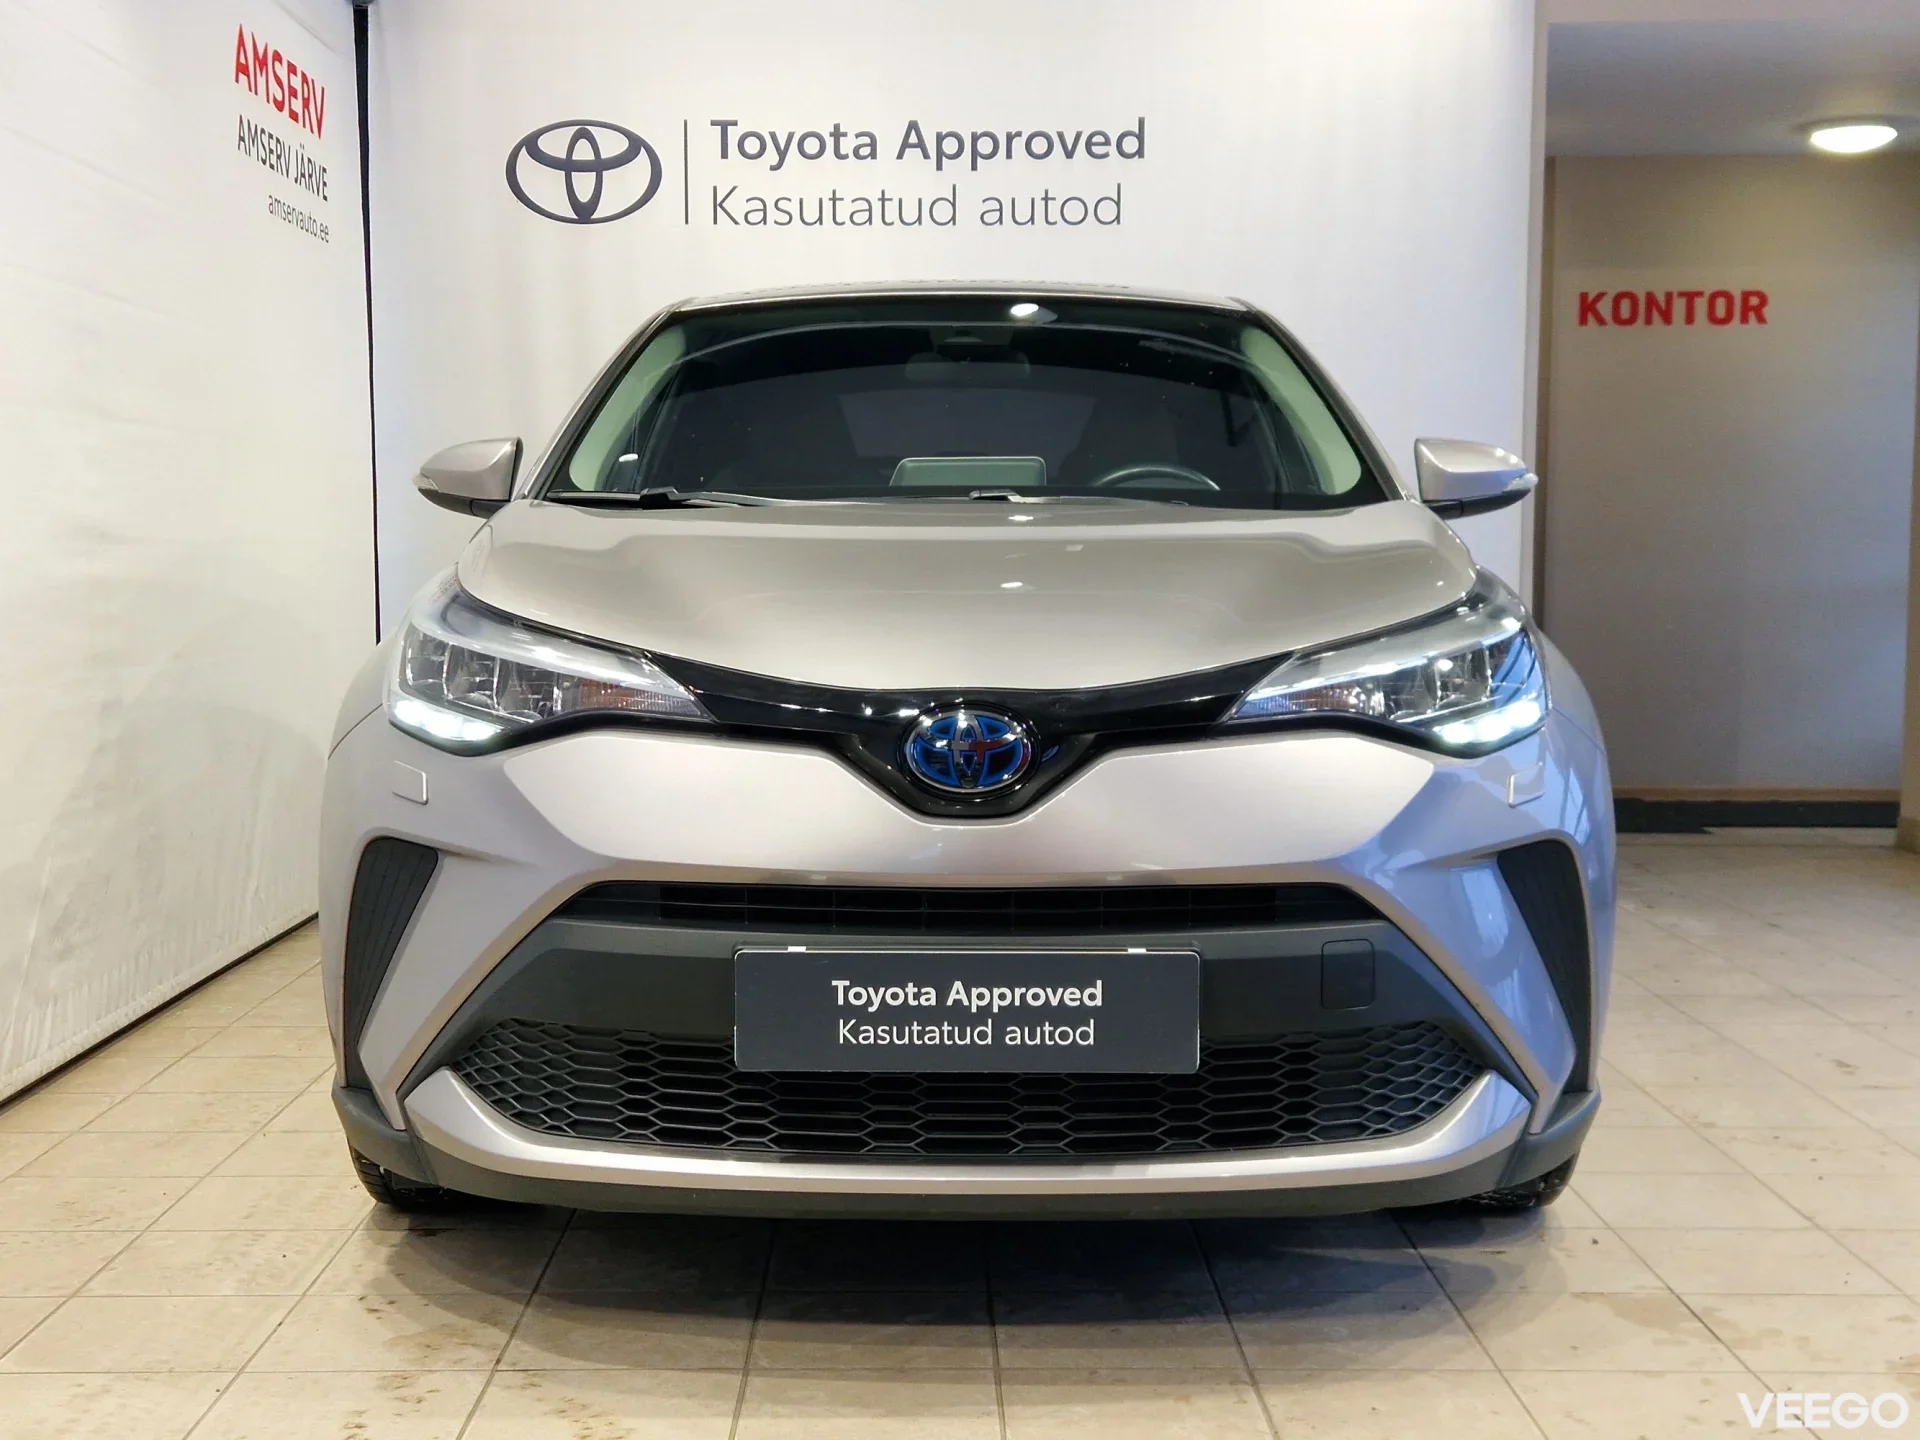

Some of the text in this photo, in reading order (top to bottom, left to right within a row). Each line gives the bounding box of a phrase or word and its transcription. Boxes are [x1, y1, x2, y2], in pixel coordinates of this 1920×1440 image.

[235, 23, 325, 139] AMSERV
[237, 113, 328, 203] AMSERV JÄRVE
[710, 116, 1146, 171] Toyota Approved
[268, 193, 329, 244] amservauto.ee
[712, 182, 1122, 226] Kasutatud autod
[1578, 290, 1770, 327] KONTOR
[831, 979, 1104, 1013] Toyota Approved
[838, 1018, 1095, 1046] Kasutatud autod
